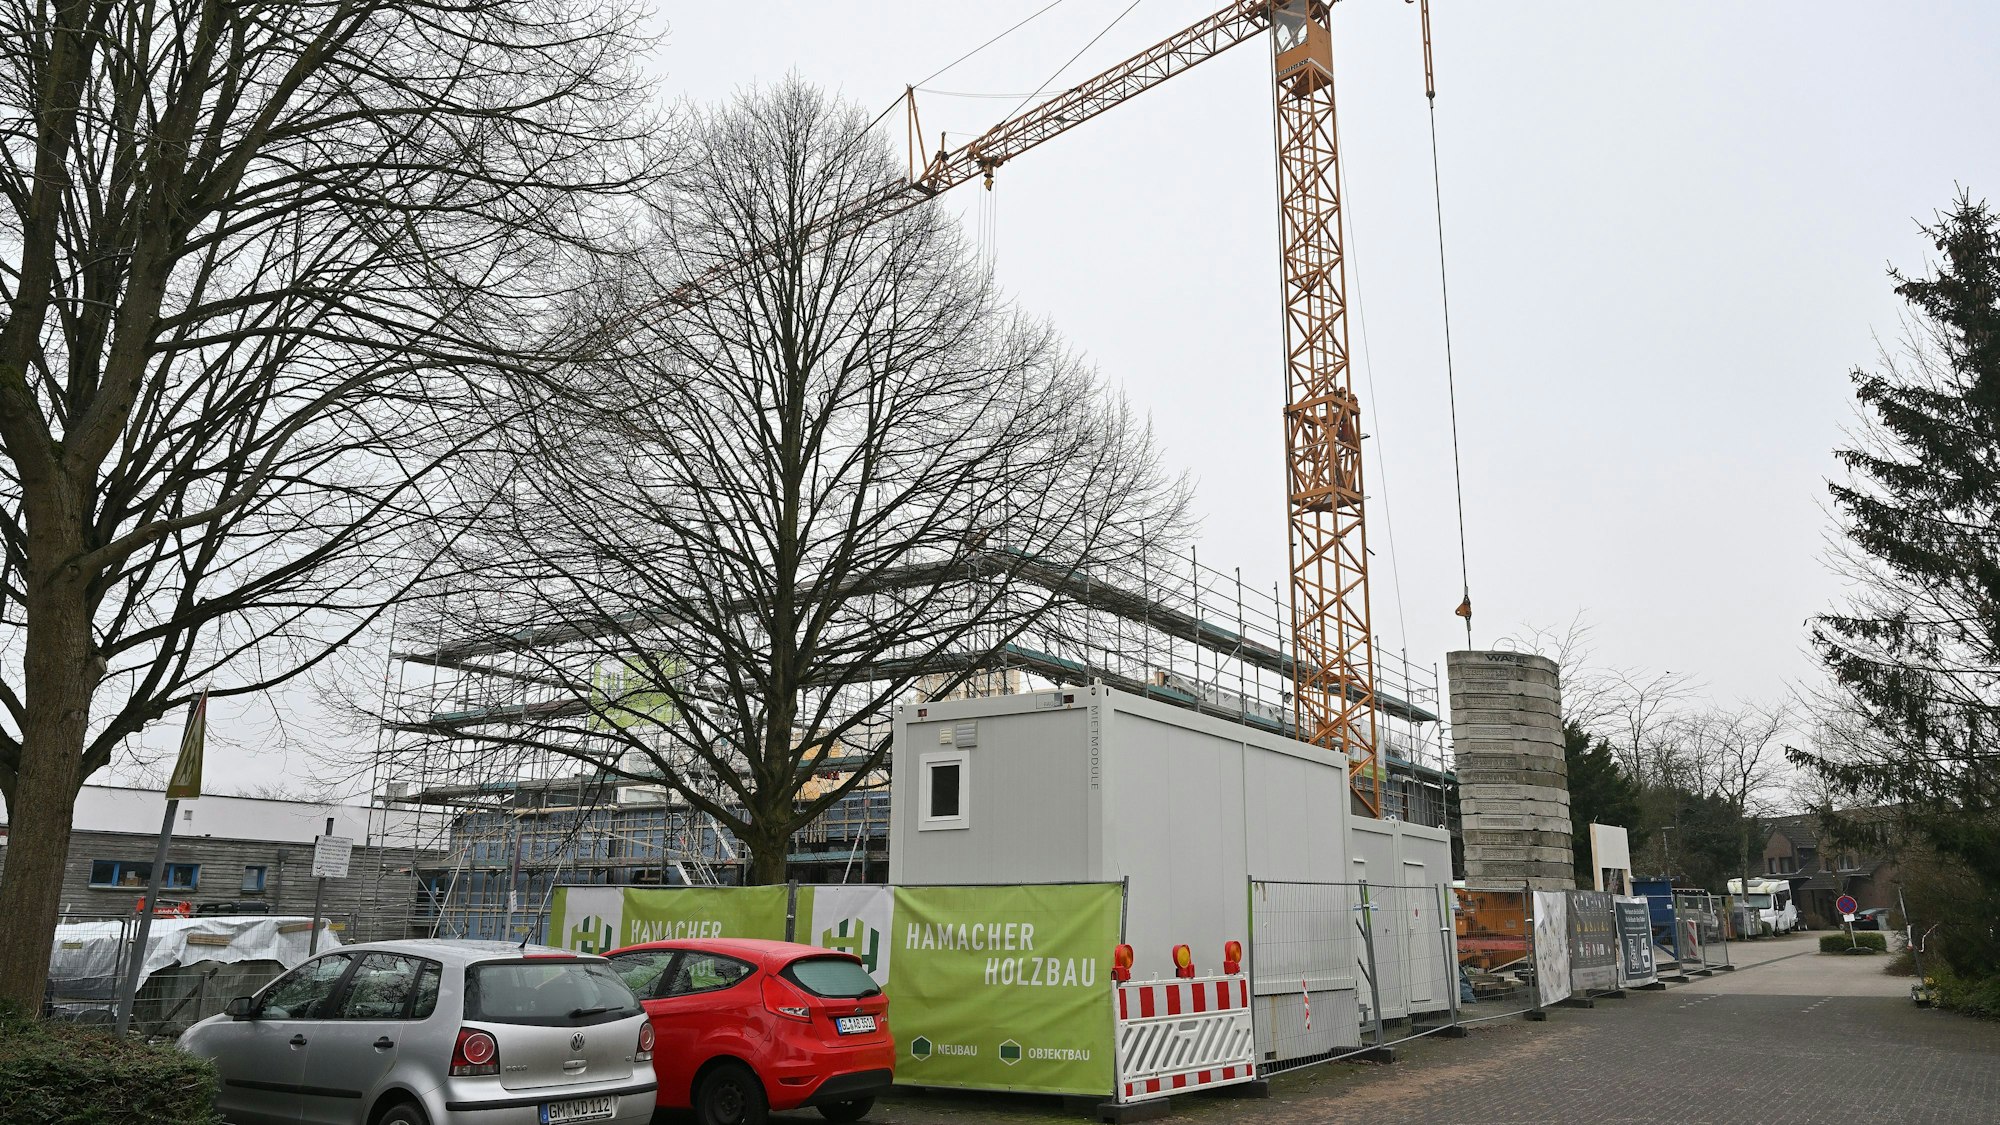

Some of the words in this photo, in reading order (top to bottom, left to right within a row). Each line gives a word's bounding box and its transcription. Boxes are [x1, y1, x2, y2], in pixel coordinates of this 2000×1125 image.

[1090, 705, 1099, 791] MIETMODULE
[631, 919, 722, 943] HAMACHER
[905, 922, 1035, 951] HAMACHER
[984, 957, 1096, 987] HOLZBAU
[937, 1044, 978, 1056] NEUBAU
[1028, 1048, 1091, 1061] OBJEKTBAU
[549, 1103, 566, 1119] GM
[573, 1101, 588, 1115] WD
[590, 1098, 610, 1114] 112
